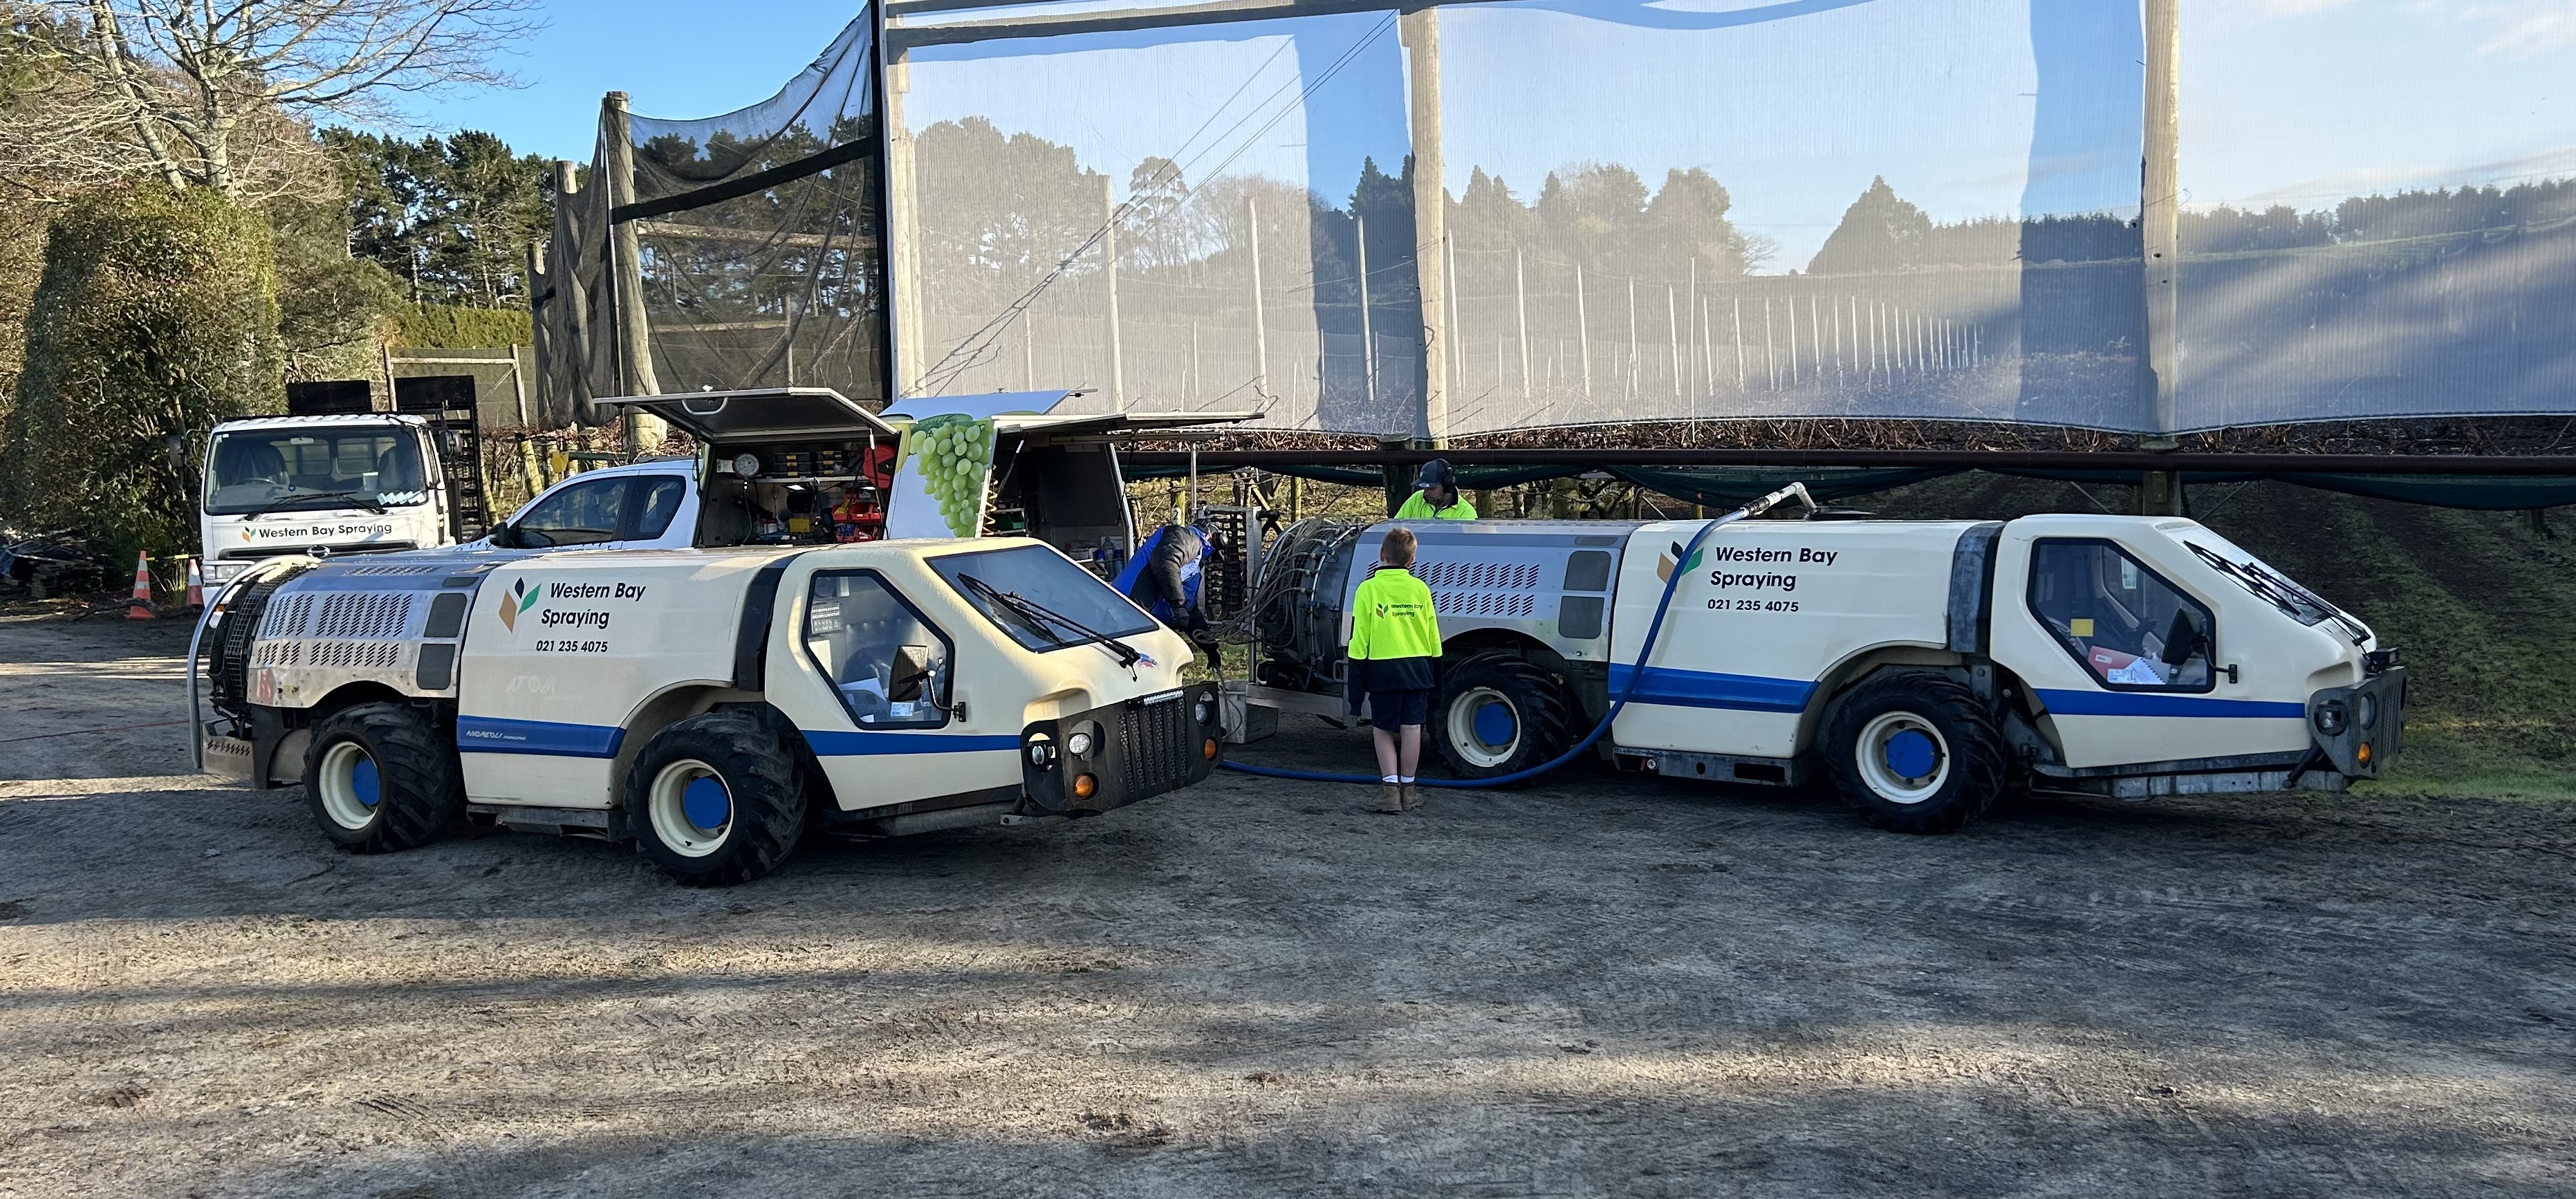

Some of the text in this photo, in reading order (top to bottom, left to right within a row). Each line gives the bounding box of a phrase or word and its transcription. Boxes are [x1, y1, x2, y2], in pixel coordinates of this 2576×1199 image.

[259, 523, 392, 538] Western Bay Spraying
[1716, 547, 1838, 566] Western Bay
[1710, 570, 1797, 592] Spraying
[550, 582, 647, 602] Western Bay
[1707, 599, 1799, 612] 021 235 4075
[541, 608, 610, 630] Spraying
[536, 640, 609, 653] 021 235 4075
